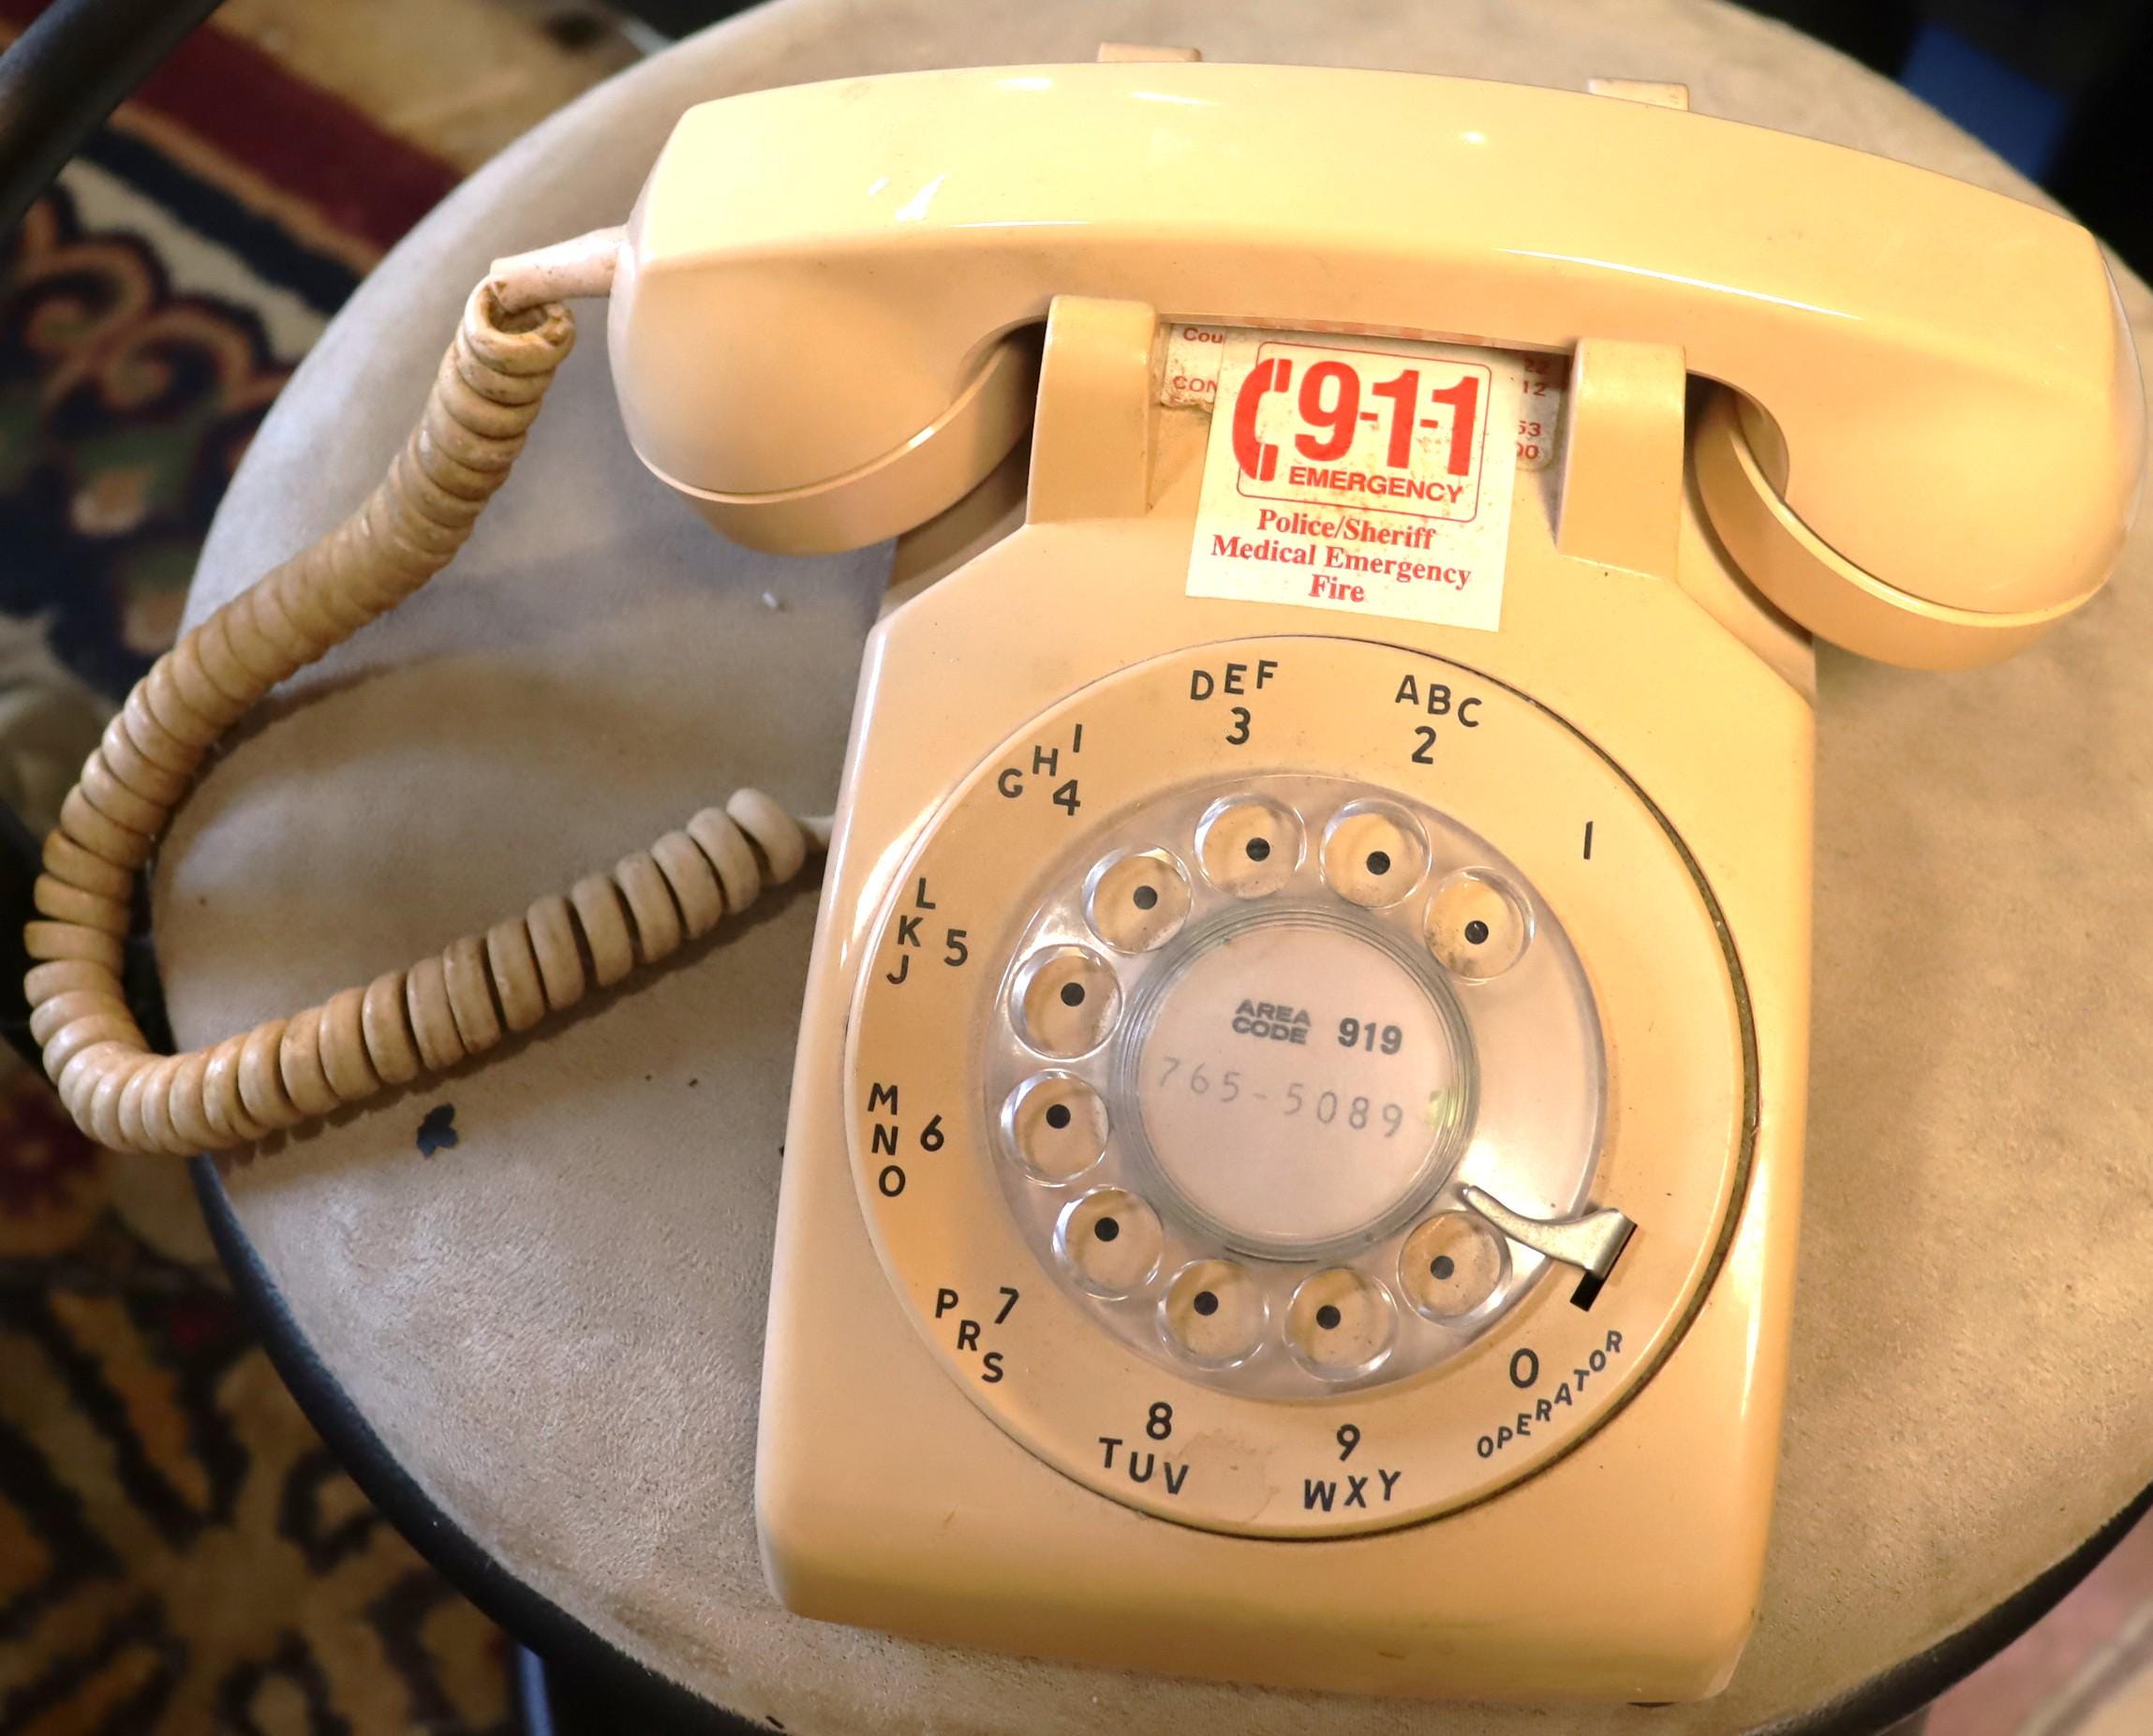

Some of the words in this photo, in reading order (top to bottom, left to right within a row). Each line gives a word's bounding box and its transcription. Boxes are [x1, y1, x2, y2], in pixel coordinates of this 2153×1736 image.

[1288, 467, 1463, 504] EMERGENCY
[1257, 508, 1436, 550] Police/Sheriff
[1211, 535, 1315, 566] Medical
[1325, 545, 1472, 590] Emergency
[1309, 574, 1365, 602] Fire
[1395, 675, 1482, 727] ABC
[1225, 707, 1251, 745] 3
[1411, 725, 1437, 764] 2
[1052, 779, 1081, 816] 4
[943, 929, 968, 967] 5
[1231, 1016, 1310, 1046] CODE
[1235, 999, 1312, 1027] AREA
[1338, 1017, 1403, 1055] 919
[920, 1116, 944, 1151] 6
[995, 1286, 1019, 1325] 7
[1477, 1329, 1623, 1458] OPERATOR
[1146, 1402, 1172, 1441] 8
[1336, 1424, 1360, 1462] 9
